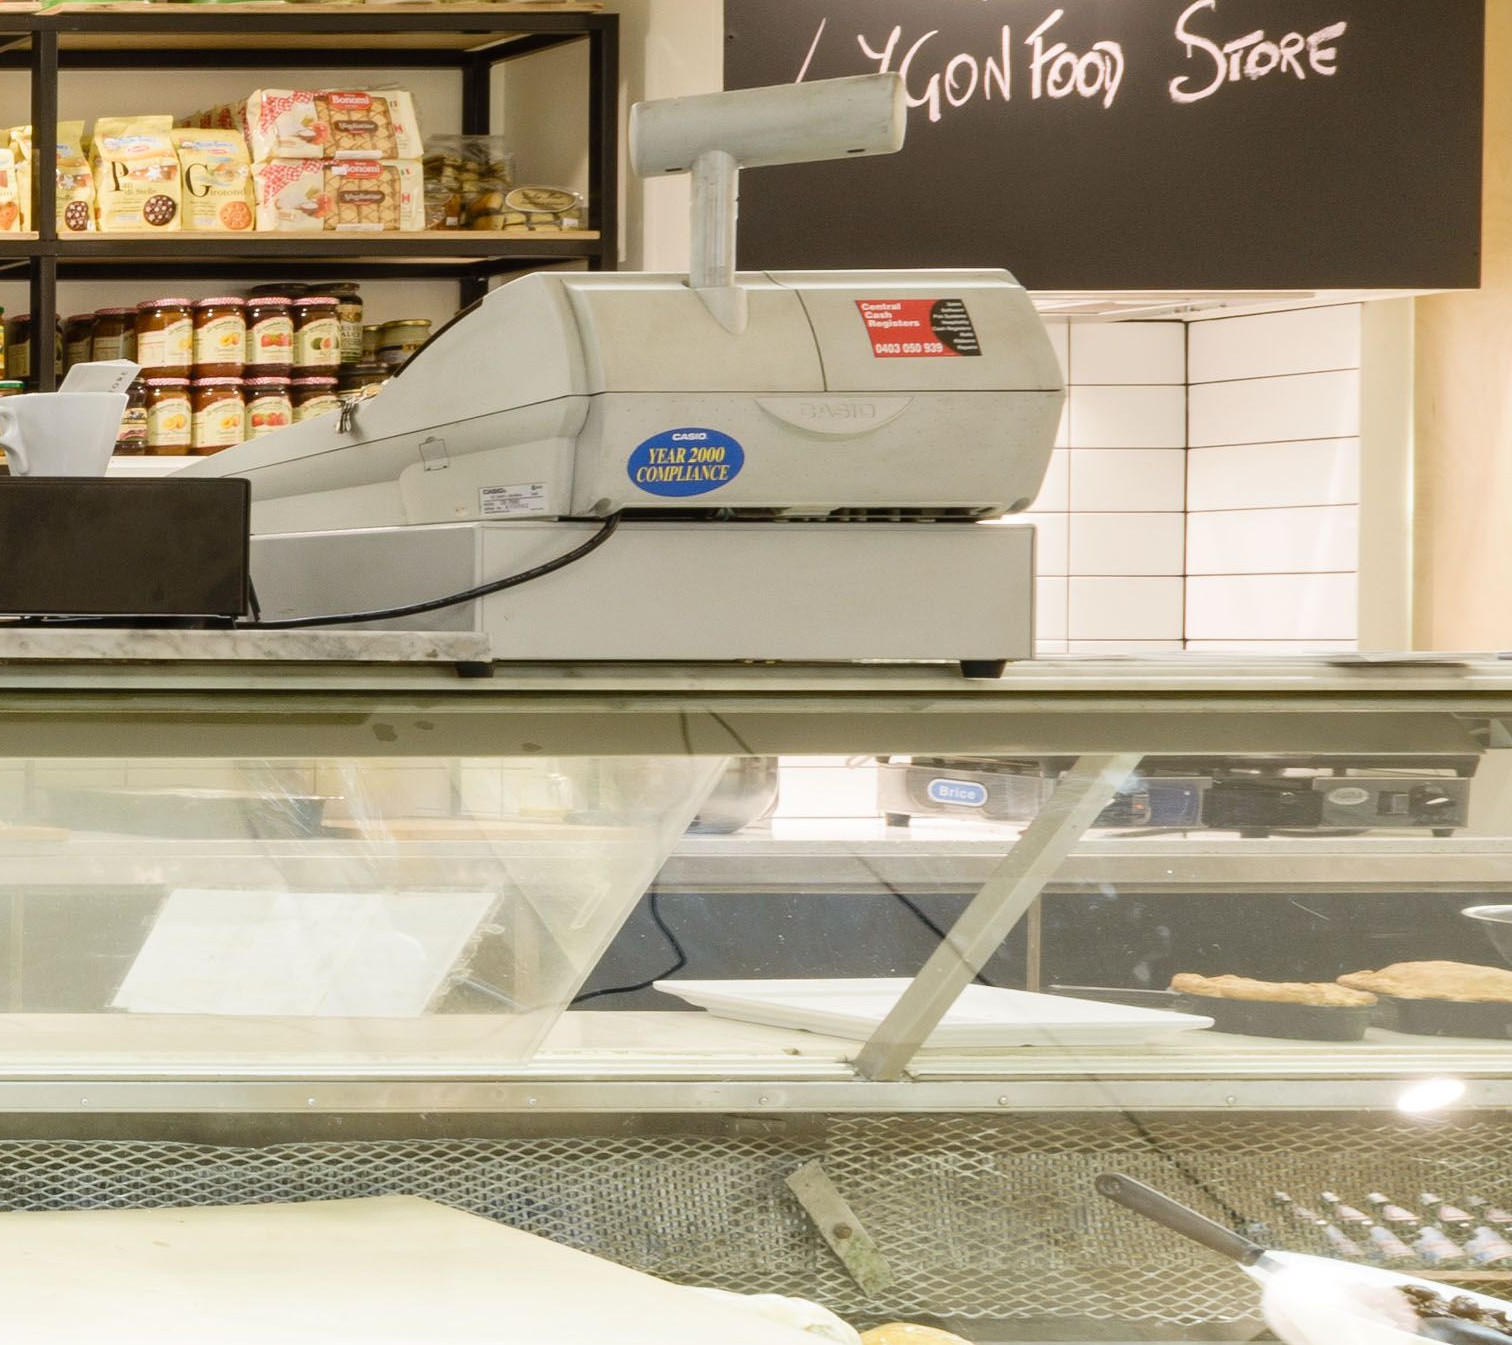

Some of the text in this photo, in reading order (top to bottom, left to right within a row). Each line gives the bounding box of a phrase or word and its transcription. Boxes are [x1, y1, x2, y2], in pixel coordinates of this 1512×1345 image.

[1025, 9, 1123, 107] FOOD
[331, 95, 370, 105] Bonomi
[869, 320, 920, 328] Registers
[875, 343, 942, 353] 0403 050 939
[672, 433, 707, 441] CASIO
[648, 446, 725, 463] YEAR 2000
[636, 464, 729, 483] COMPLIANCE
[938, 783, 976, 801] Brice
